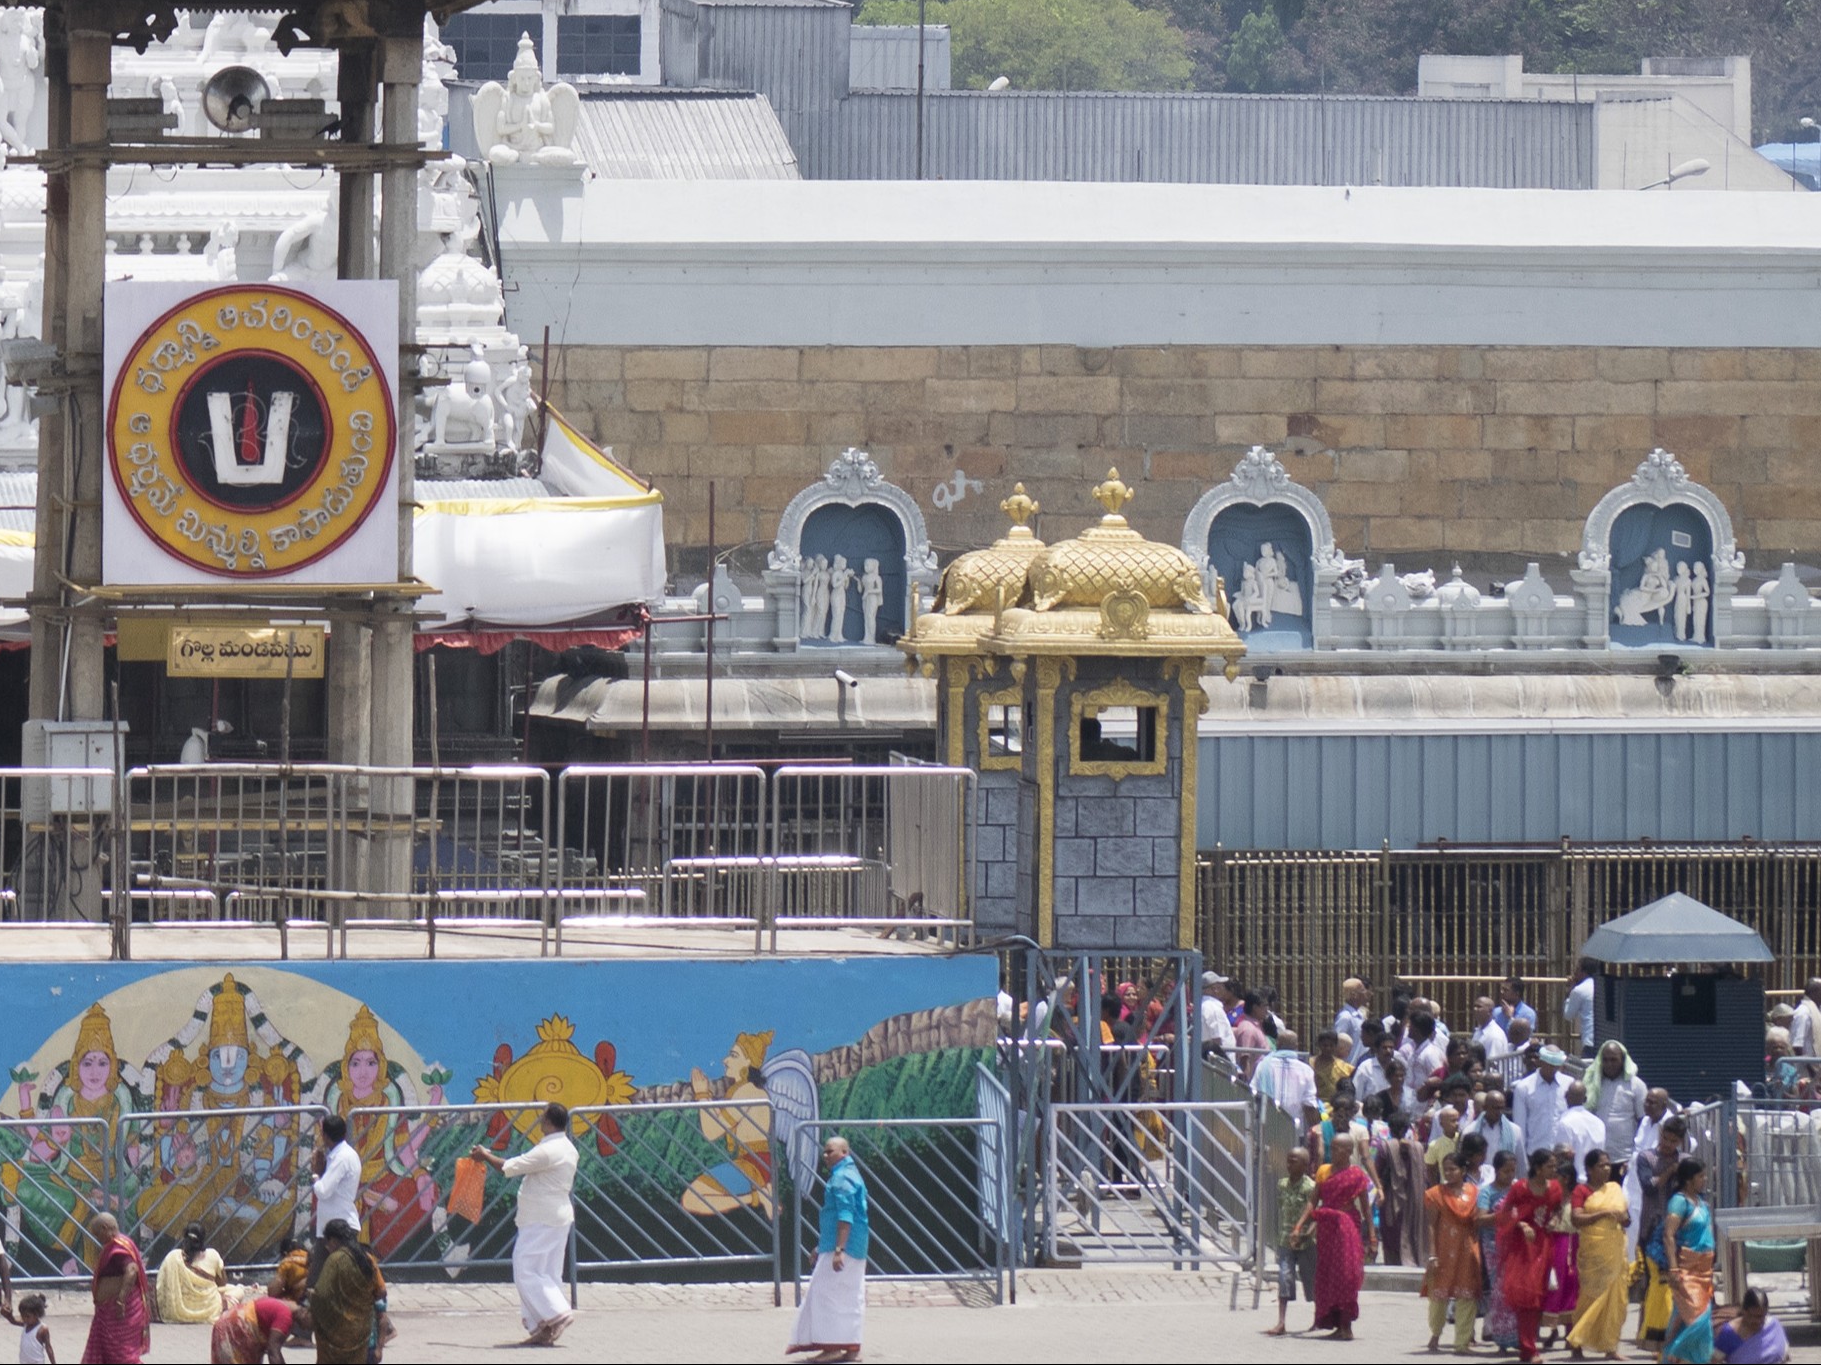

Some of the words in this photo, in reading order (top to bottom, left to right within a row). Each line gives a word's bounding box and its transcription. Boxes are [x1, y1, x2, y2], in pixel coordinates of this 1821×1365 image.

[135, 319, 220, 393] ధర్మాన్ని
[217, 300, 373, 392] ఆచరించండి
[130, 413, 152, 434] ఆ
[126, 442, 185, 516] ధర్మమే
[268, 410, 374, 552] కాపాడుతుంది
[176, 508, 267, 570] మిమ్మల్ని
[180, 639, 215, 663] గొల్ల
[219, 640, 313, 658] మండపము
